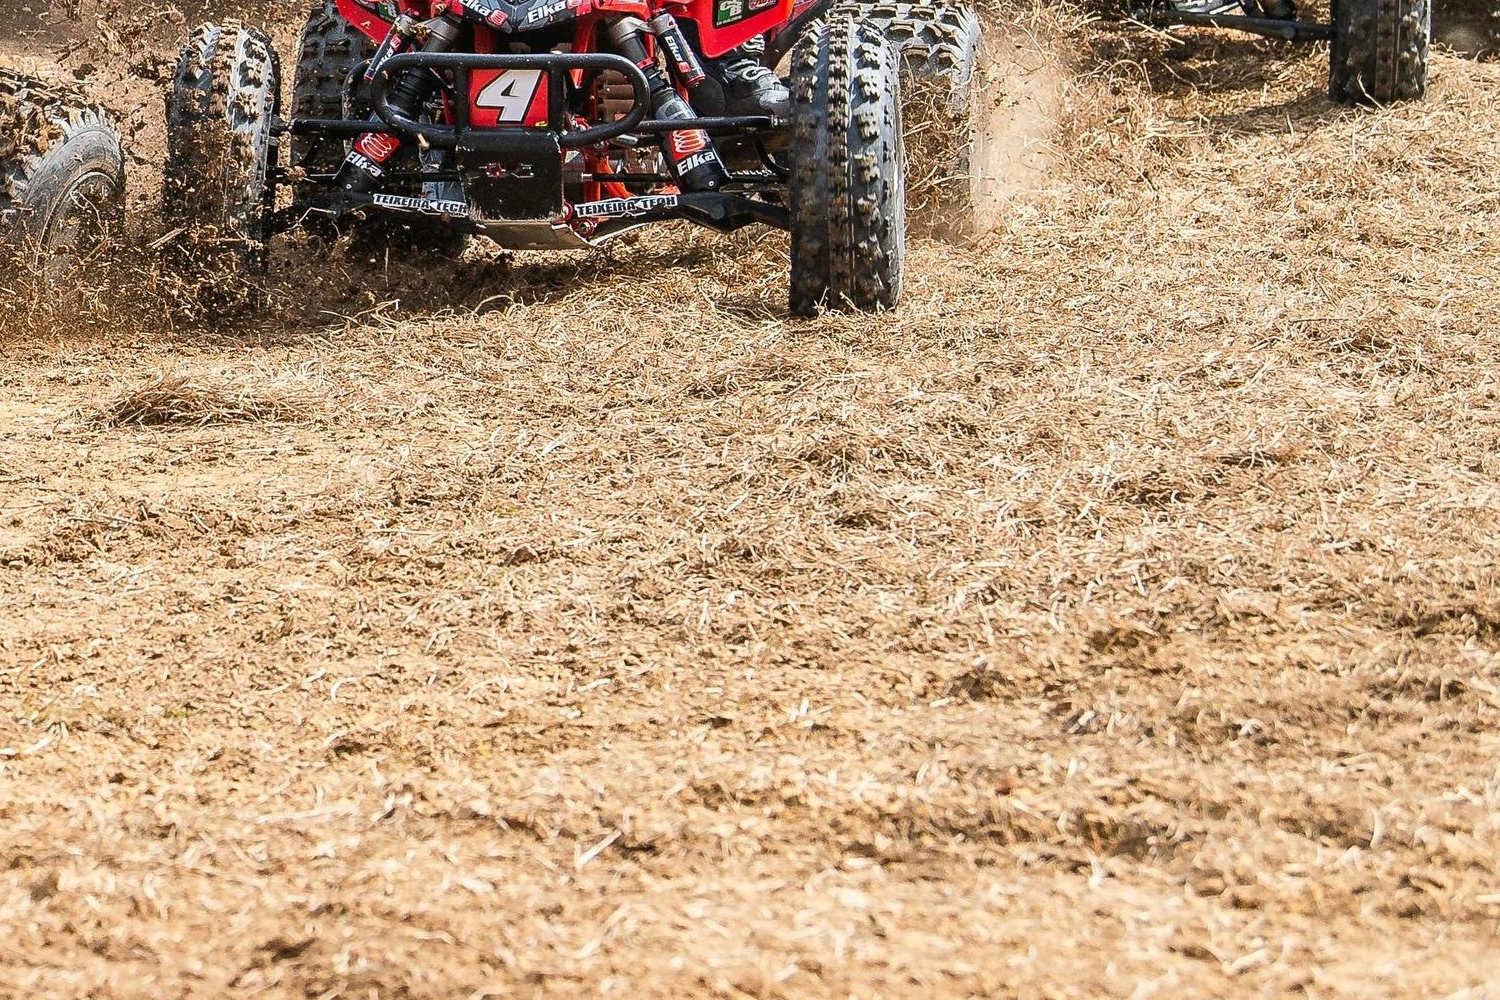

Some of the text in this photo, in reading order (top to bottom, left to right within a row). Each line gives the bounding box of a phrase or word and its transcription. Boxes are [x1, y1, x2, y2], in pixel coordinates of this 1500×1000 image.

[664, 34, 683, 63] Elka
[477, 69, 544, 122] 4
[346, 150, 382, 178] Elka
[676, 151, 716, 177] Elka
[373, 193, 468, 216] TEIXEIRA TECH
[575, 196, 677, 216] TEIXEIRA TECH
